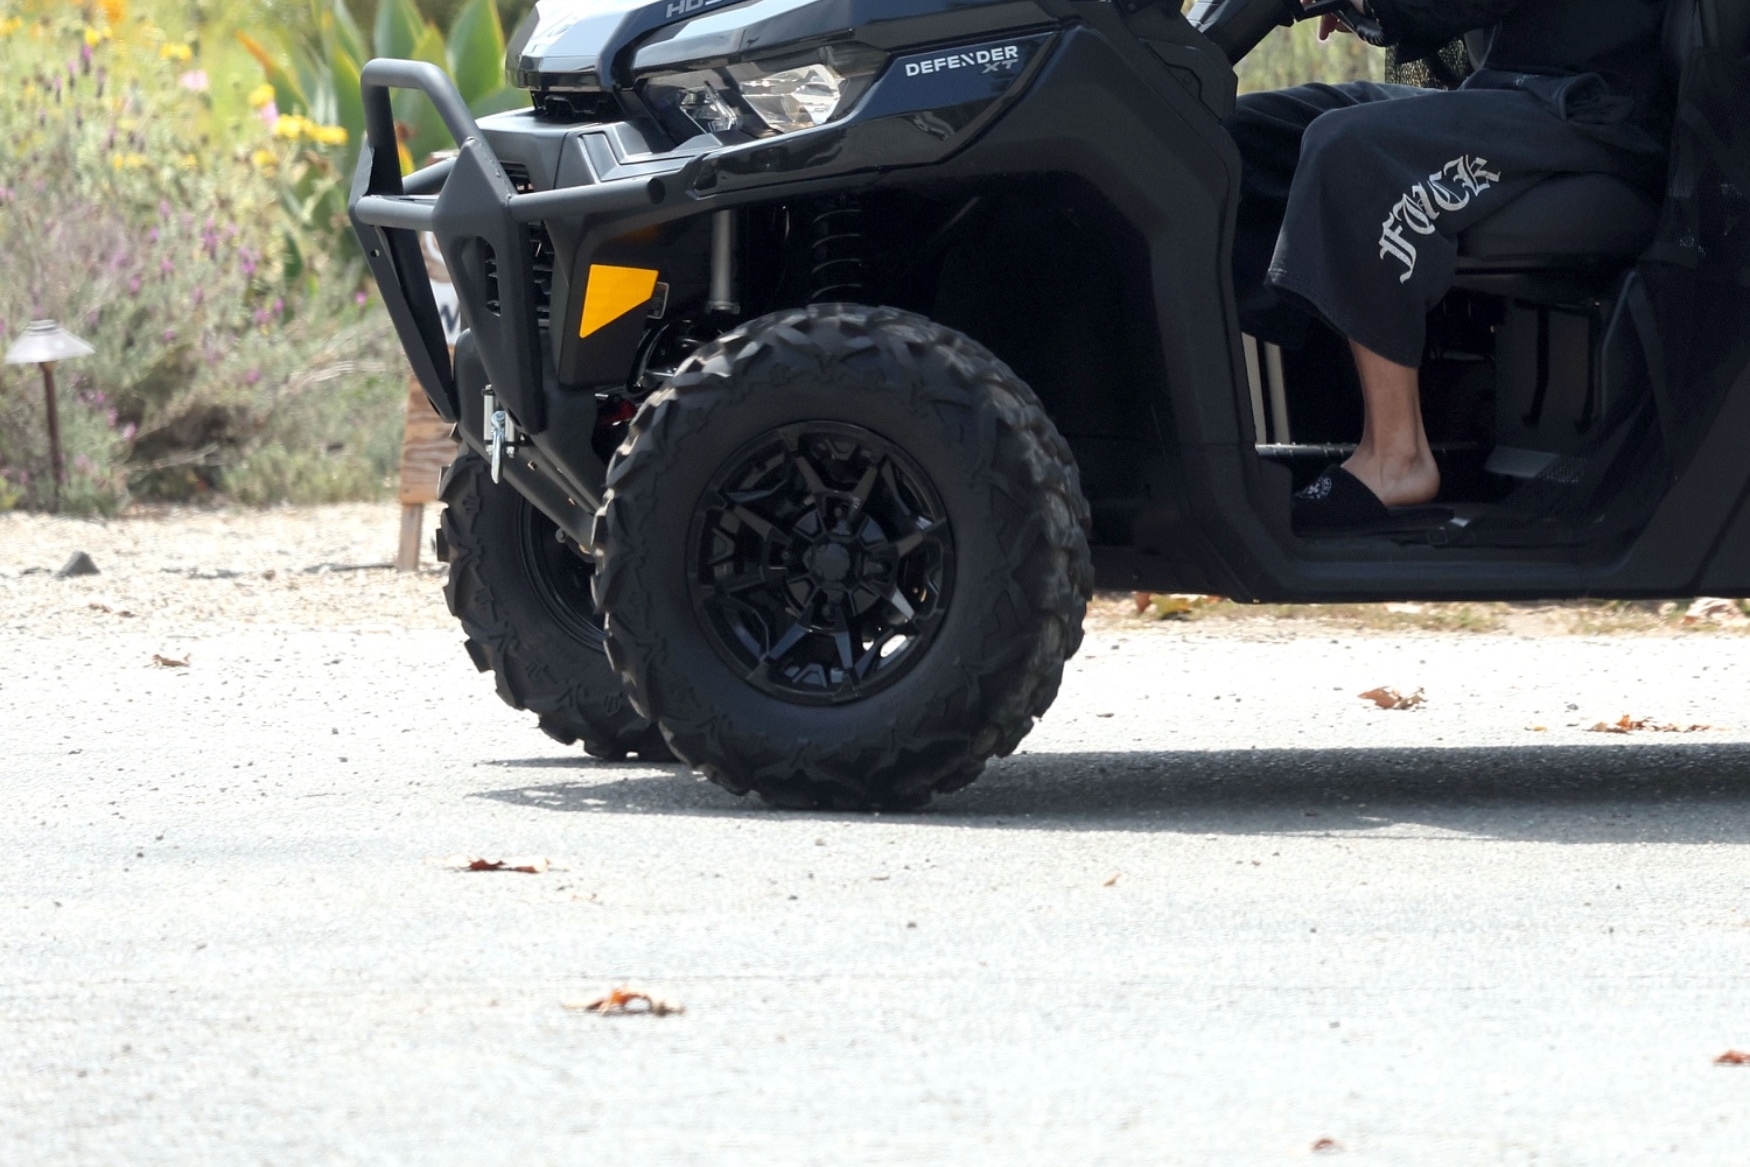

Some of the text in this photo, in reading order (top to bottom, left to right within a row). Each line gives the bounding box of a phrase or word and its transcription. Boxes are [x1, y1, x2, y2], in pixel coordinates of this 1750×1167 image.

[905, 45, 1018, 76] DEFENDER
[982, 58, 1018, 73] XT
[1379, 154, 1501, 284] FUCK
